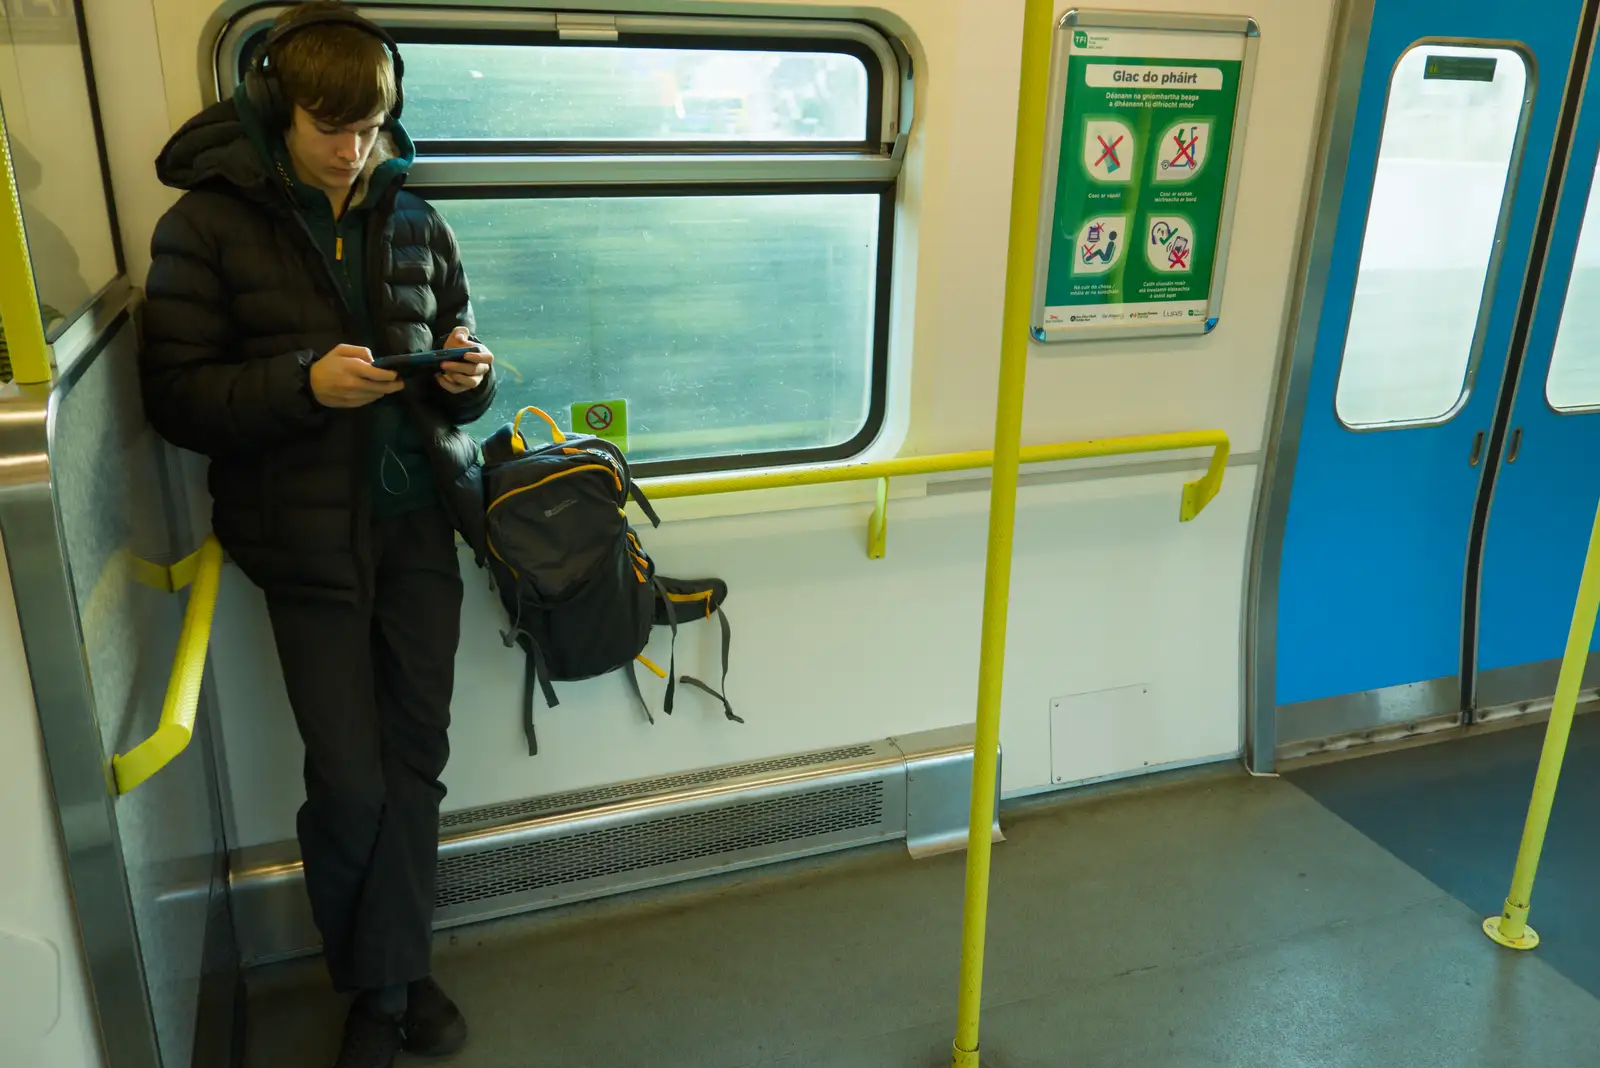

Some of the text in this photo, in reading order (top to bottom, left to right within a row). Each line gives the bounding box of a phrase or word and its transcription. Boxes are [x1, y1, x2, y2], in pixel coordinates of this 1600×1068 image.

[1113, 70, 1198, 85] Glac do pháirt
